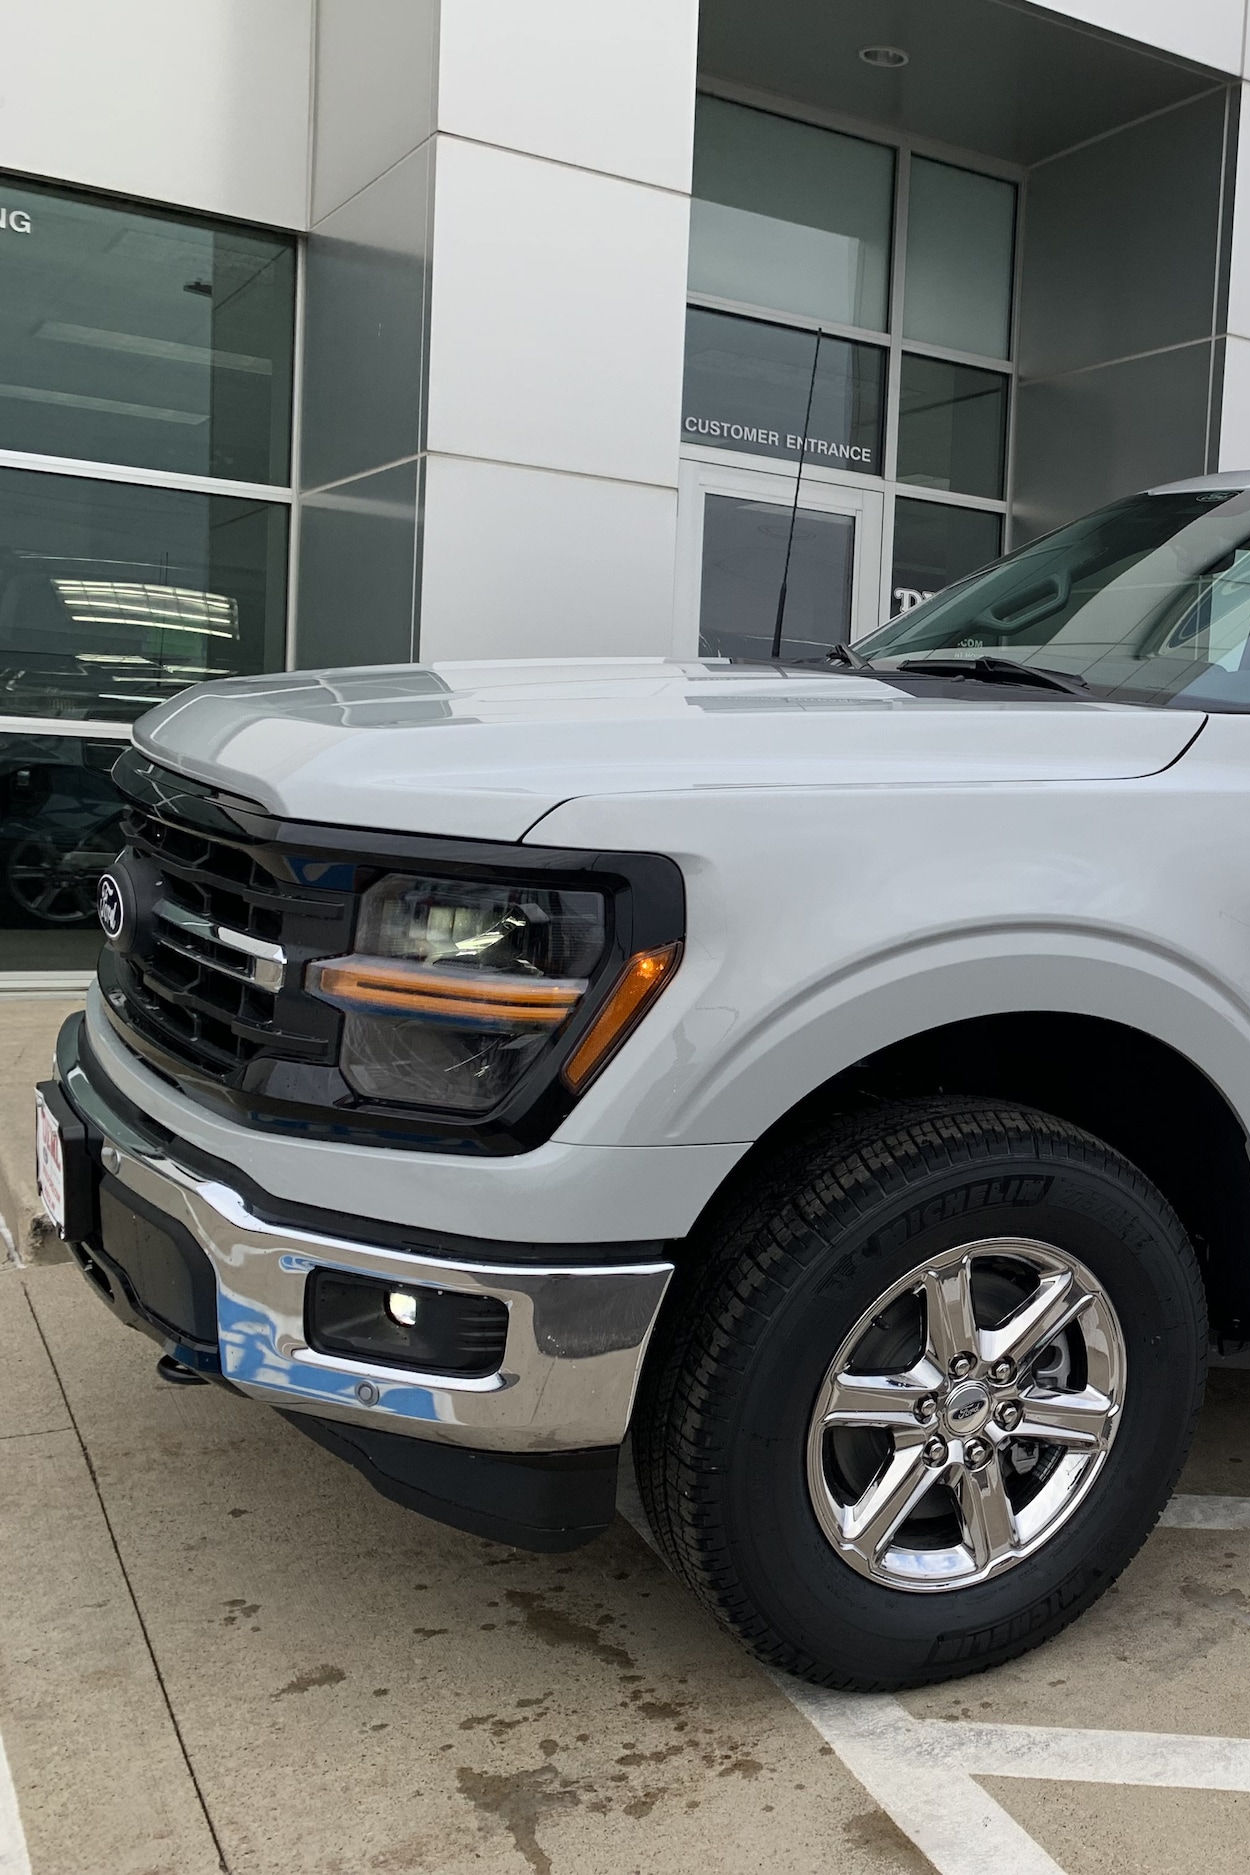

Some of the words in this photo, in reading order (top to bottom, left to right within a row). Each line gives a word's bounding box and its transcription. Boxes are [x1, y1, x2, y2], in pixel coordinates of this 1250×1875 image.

[685, 416, 780, 447] CUSTOMER
[786, 434, 872, 463] ENTRANCE
[100, 881, 118, 930] Ford
[876, 1176, 1048, 1254] MICHELIN
